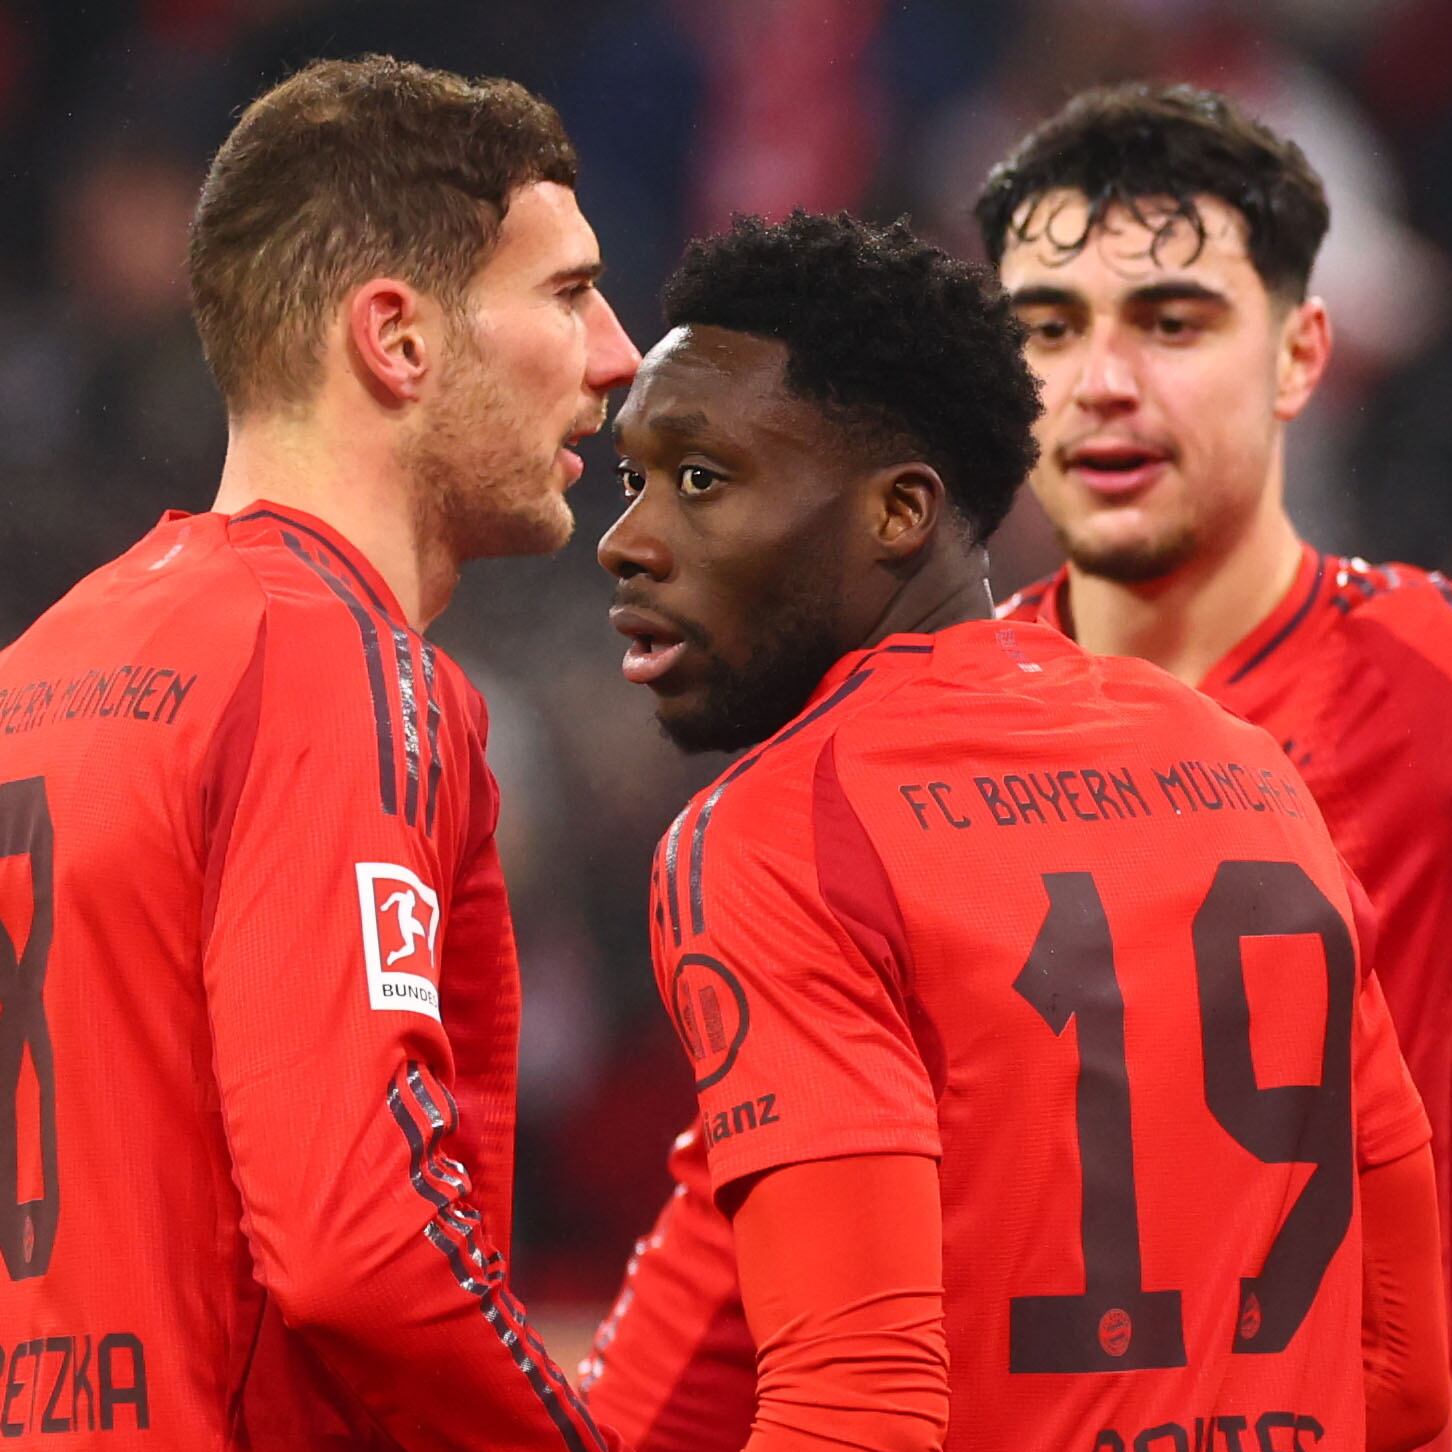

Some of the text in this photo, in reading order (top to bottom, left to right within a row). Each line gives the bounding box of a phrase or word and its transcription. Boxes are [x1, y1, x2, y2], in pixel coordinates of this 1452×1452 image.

[899, 782, 971, 830] FC
[973, 767, 1152, 827] BAYERN
[1010, 859, 1355, 1374] 19
[0, 1333, 150, 1438] ETZKA
